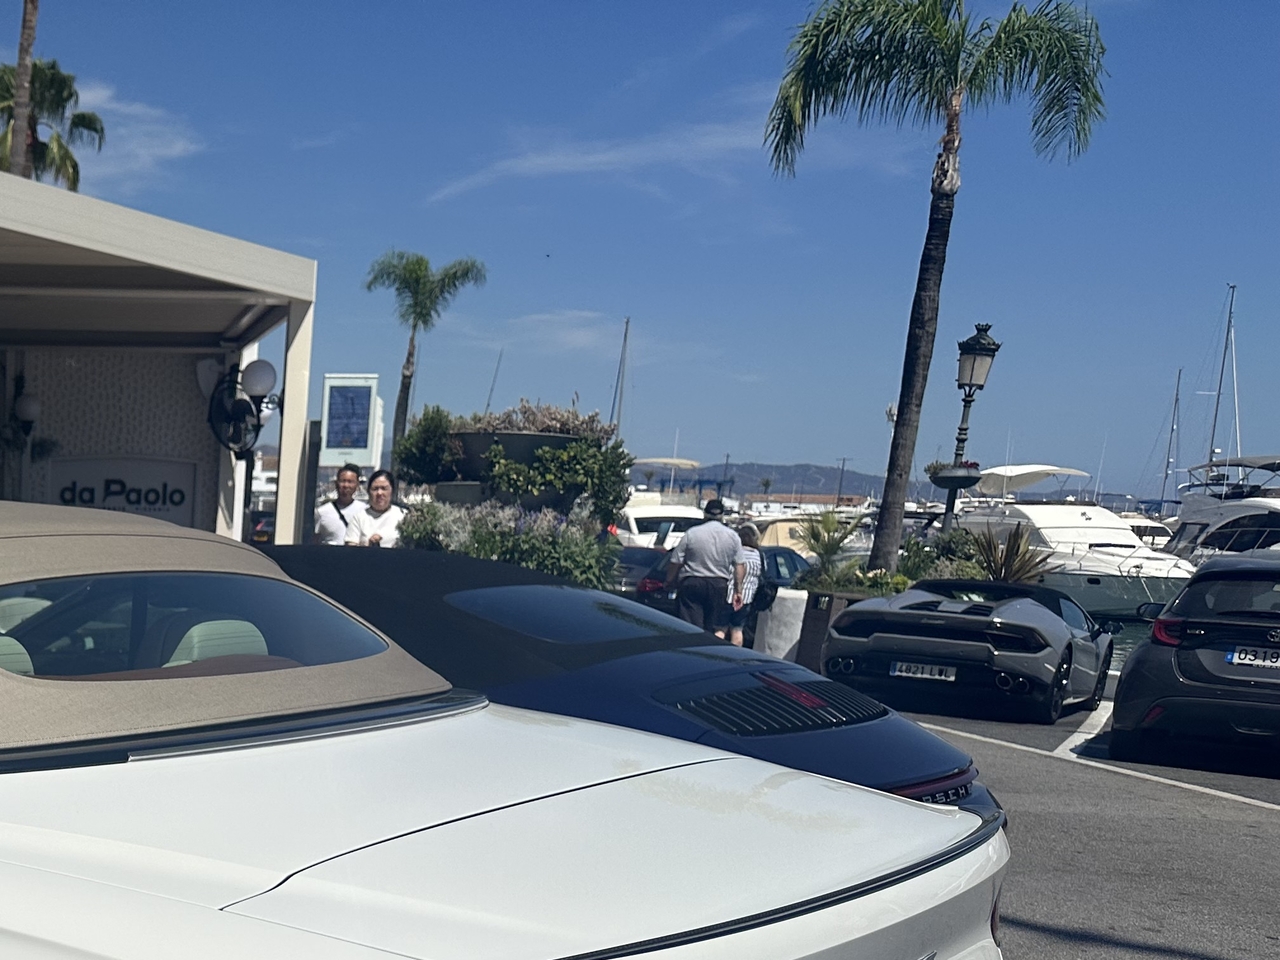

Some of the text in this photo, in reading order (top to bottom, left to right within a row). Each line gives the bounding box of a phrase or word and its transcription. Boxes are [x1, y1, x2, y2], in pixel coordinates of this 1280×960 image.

[60, 478, 185, 506] da Paolo
[897, 663, 925, 676] 4821
